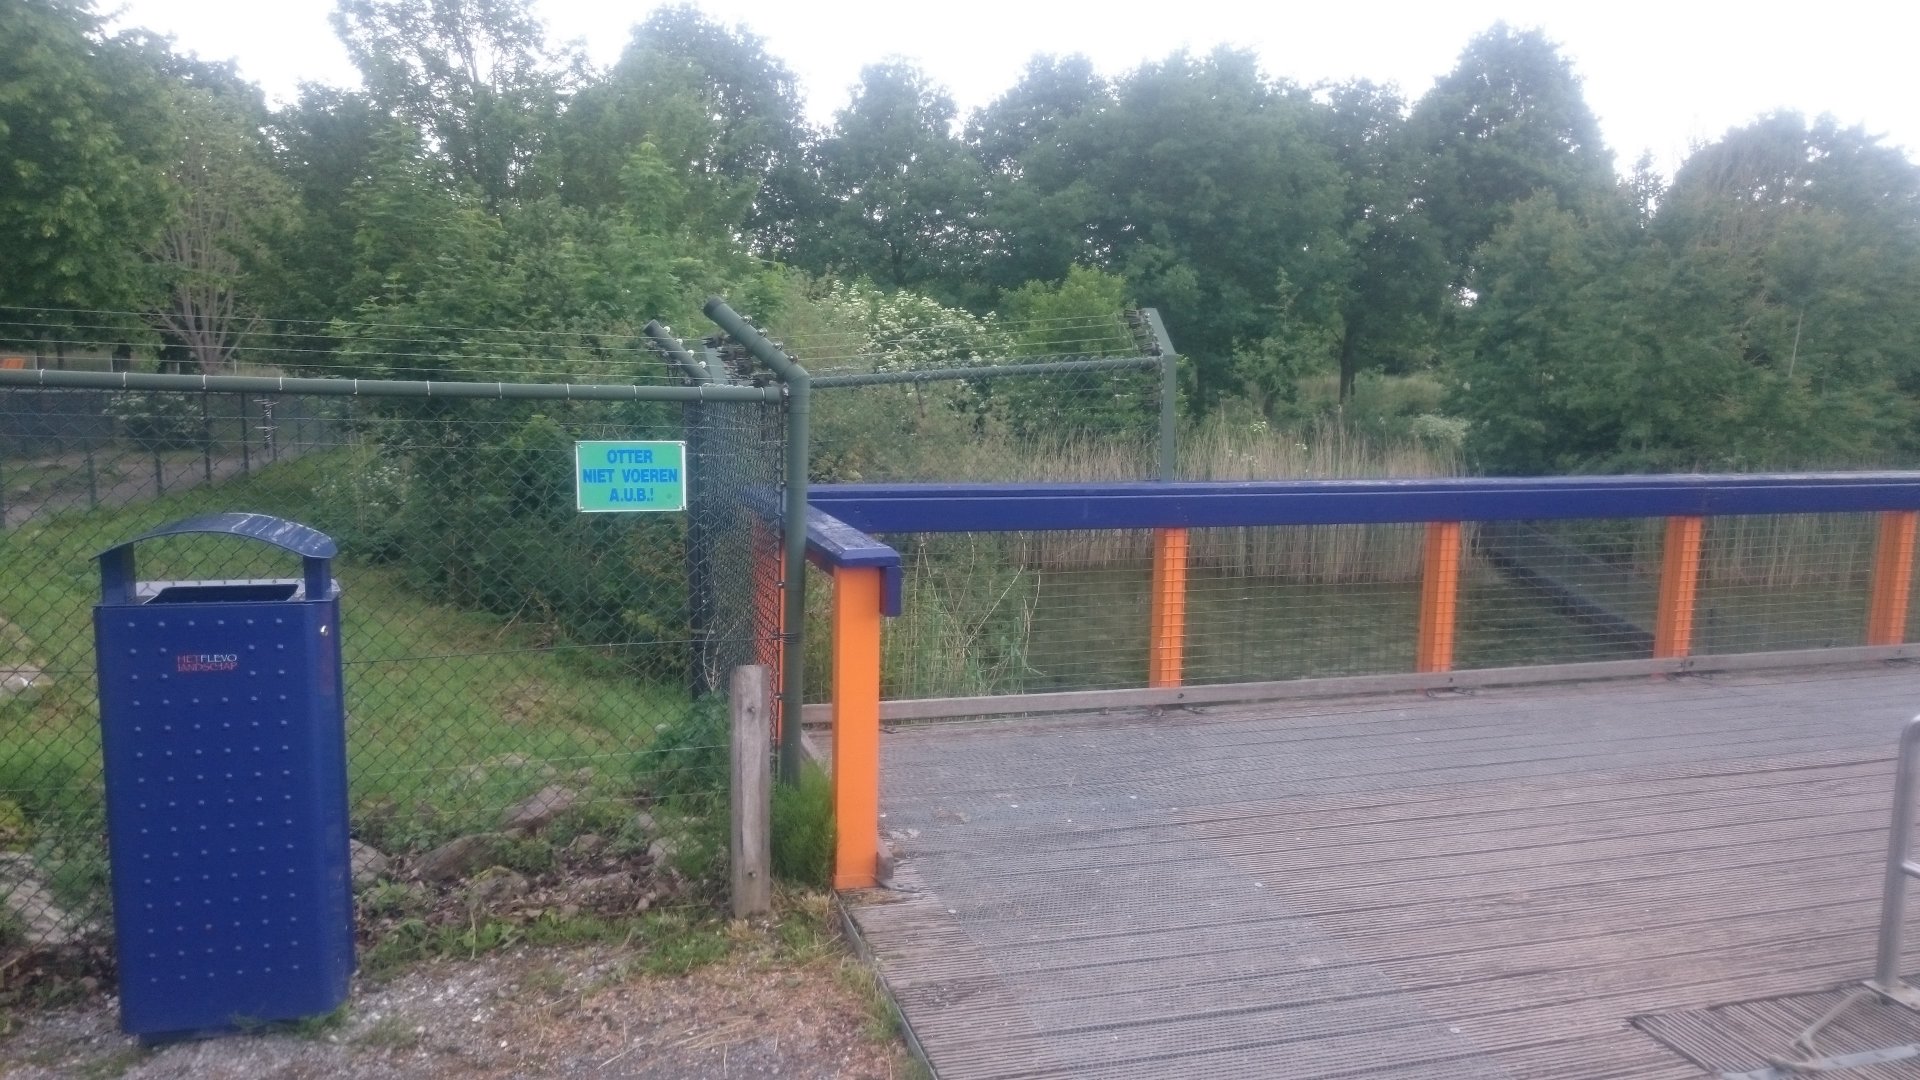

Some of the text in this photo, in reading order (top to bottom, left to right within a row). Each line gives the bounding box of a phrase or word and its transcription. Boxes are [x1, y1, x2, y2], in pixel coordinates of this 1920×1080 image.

[607, 449, 653, 464] OTTER
[583, 468, 678, 483] NIET VOEREN
[609, 487, 654, 502] A.U.B.!
